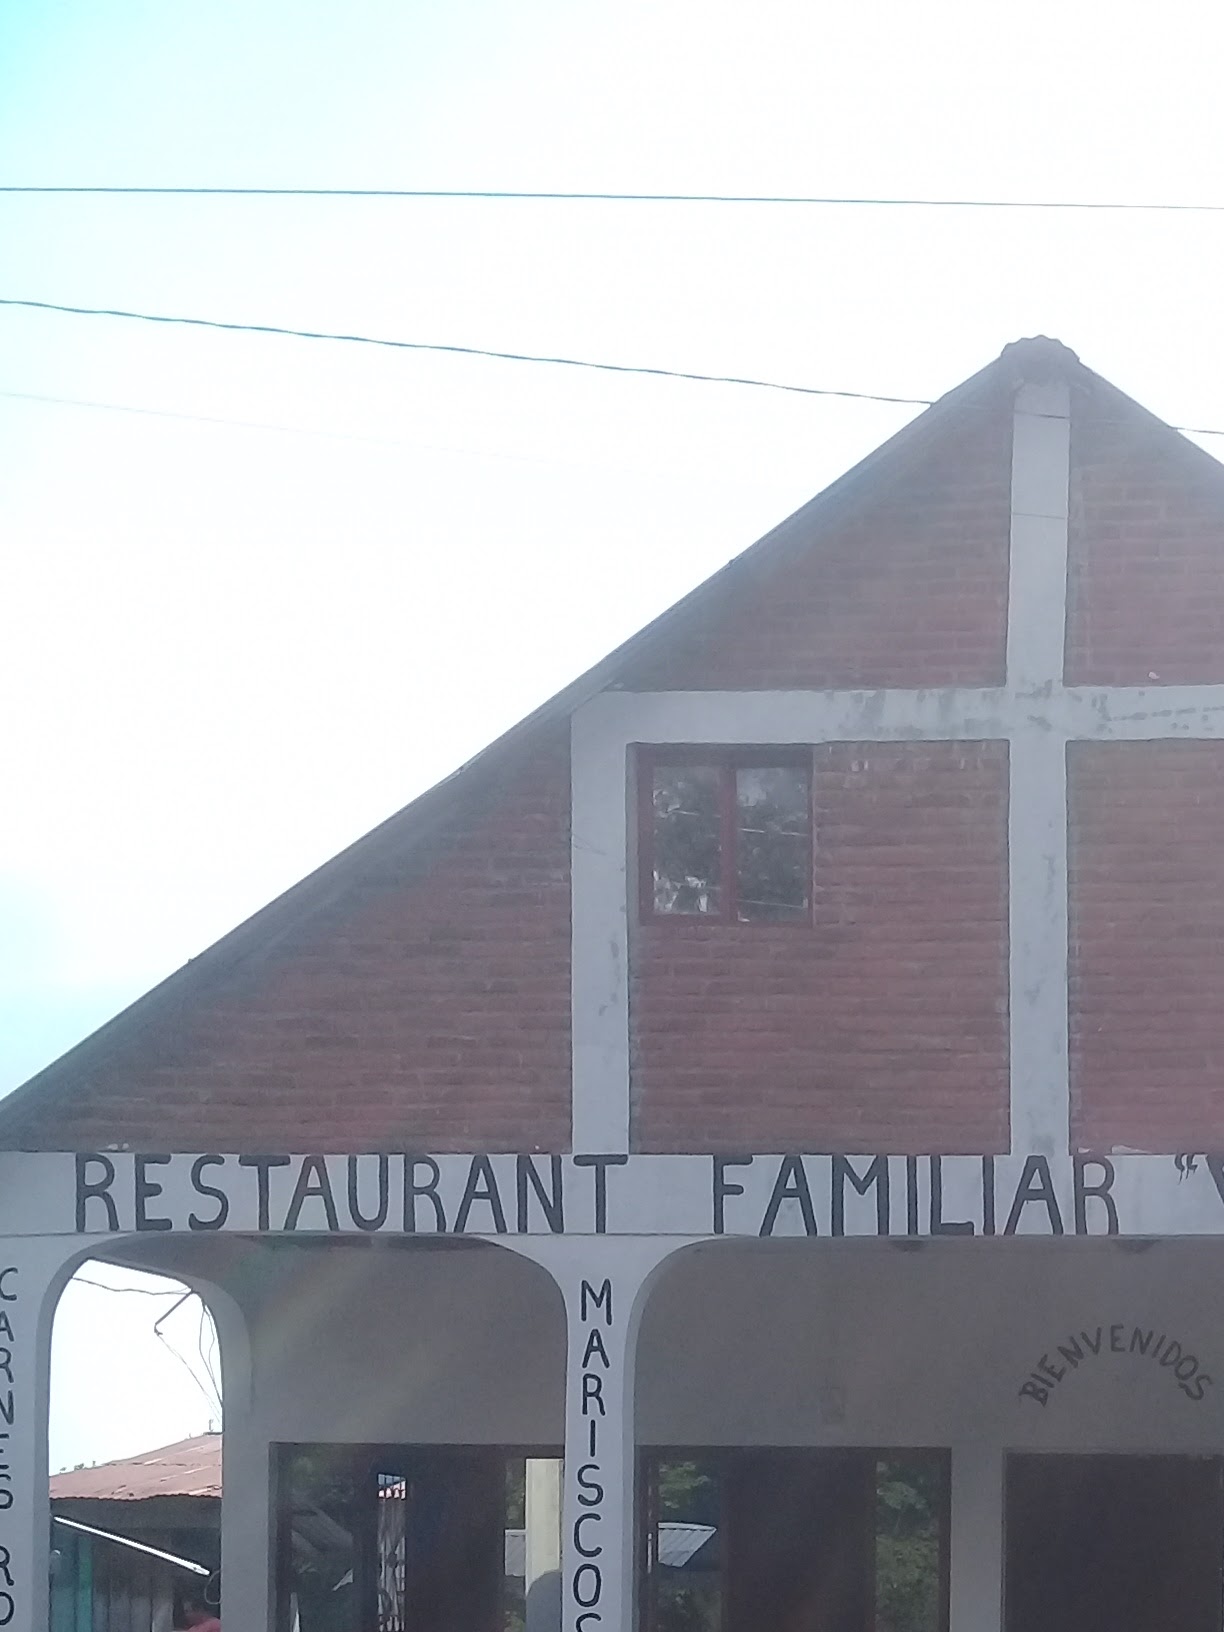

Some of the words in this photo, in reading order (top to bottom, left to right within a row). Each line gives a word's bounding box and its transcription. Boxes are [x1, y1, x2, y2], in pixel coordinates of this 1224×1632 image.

[75, 1153, 628, 1234] RESTAURANT
[711, 1153, 1120, 1236] FAMILIAR
[1018, 1323, 1214, 1407] BIENVENIDOS
